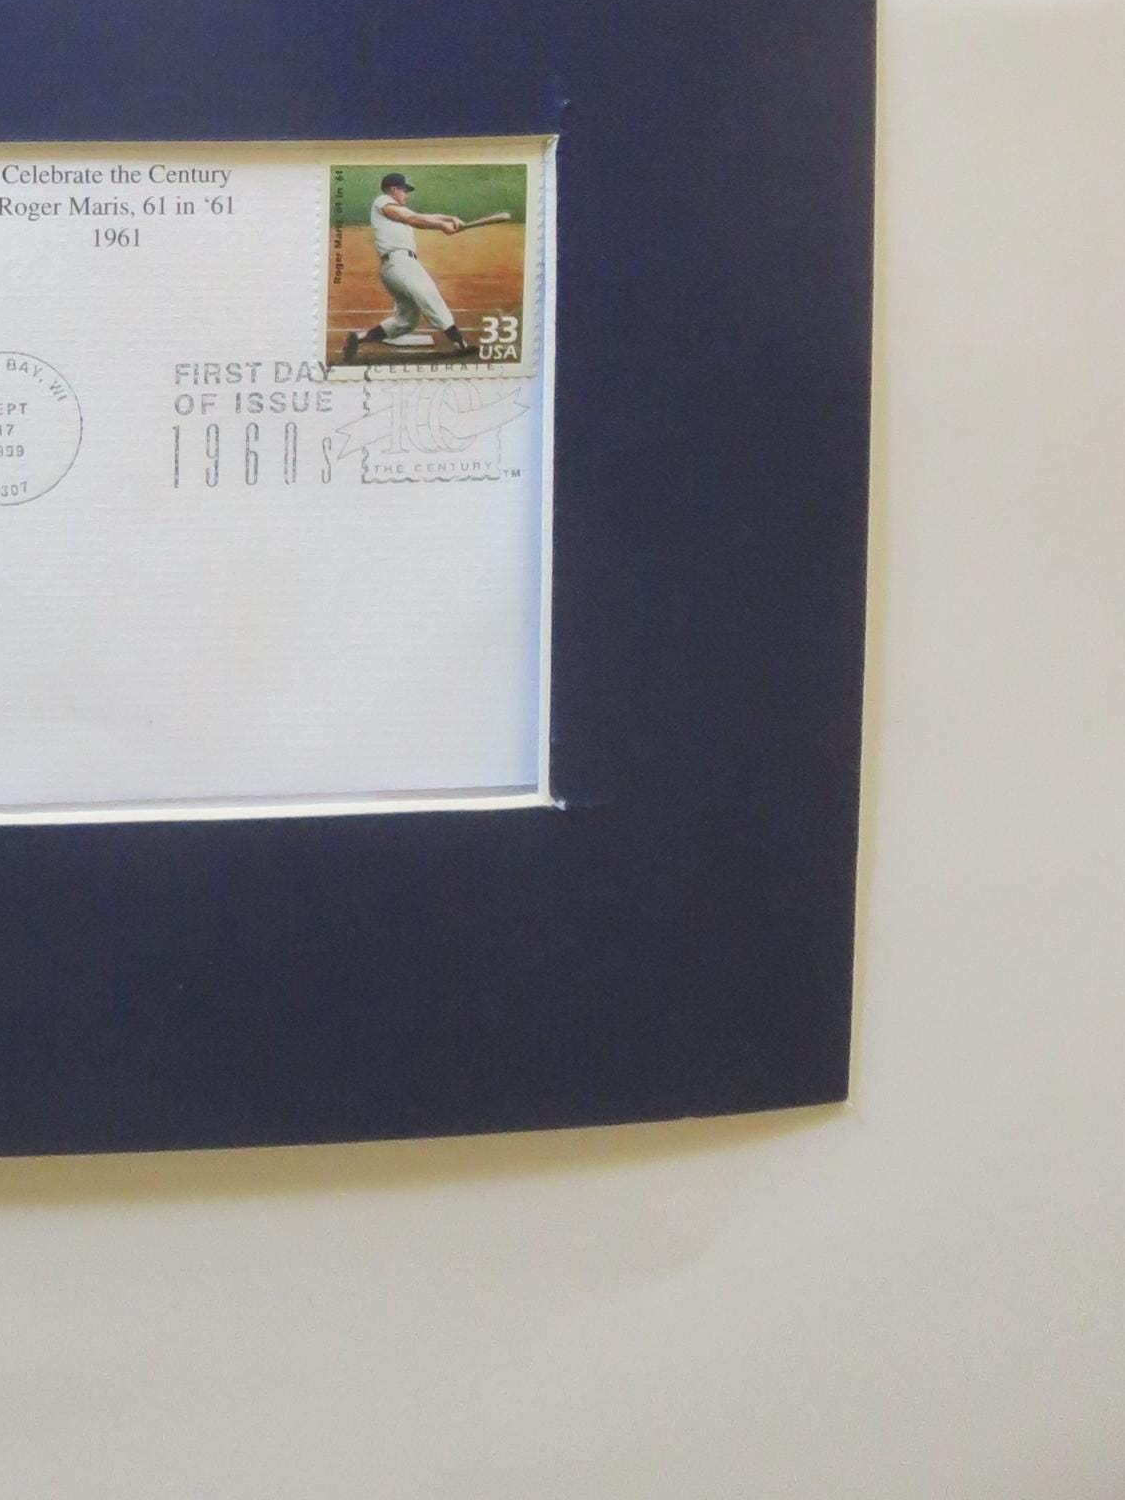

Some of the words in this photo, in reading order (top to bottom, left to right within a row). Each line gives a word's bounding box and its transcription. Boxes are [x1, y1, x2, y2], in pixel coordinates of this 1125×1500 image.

[1, 164, 103, 185] Celebrate
[110, 165, 142, 184] the
[148, 164, 232, 188] Century
[335, 187, 344, 198] in
[69, 196, 136, 218] Maris,
[143, 196, 166, 216] 61
[175, 197, 195, 216] in
[93, 227, 141, 248] 1961
[333, 253, 344, 285] Roger
[479, 316, 518, 343] 33
[479, 344, 518, 359] USA
[175, 362, 262, 385] FIRST
[274, 361, 333, 383] DAY
[174, 393, 217, 416] OF
[235, 391, 333, 414] ISSUE
[374, 464, 404, 474] THE
[413, 461, 493, 473] CENTURY
